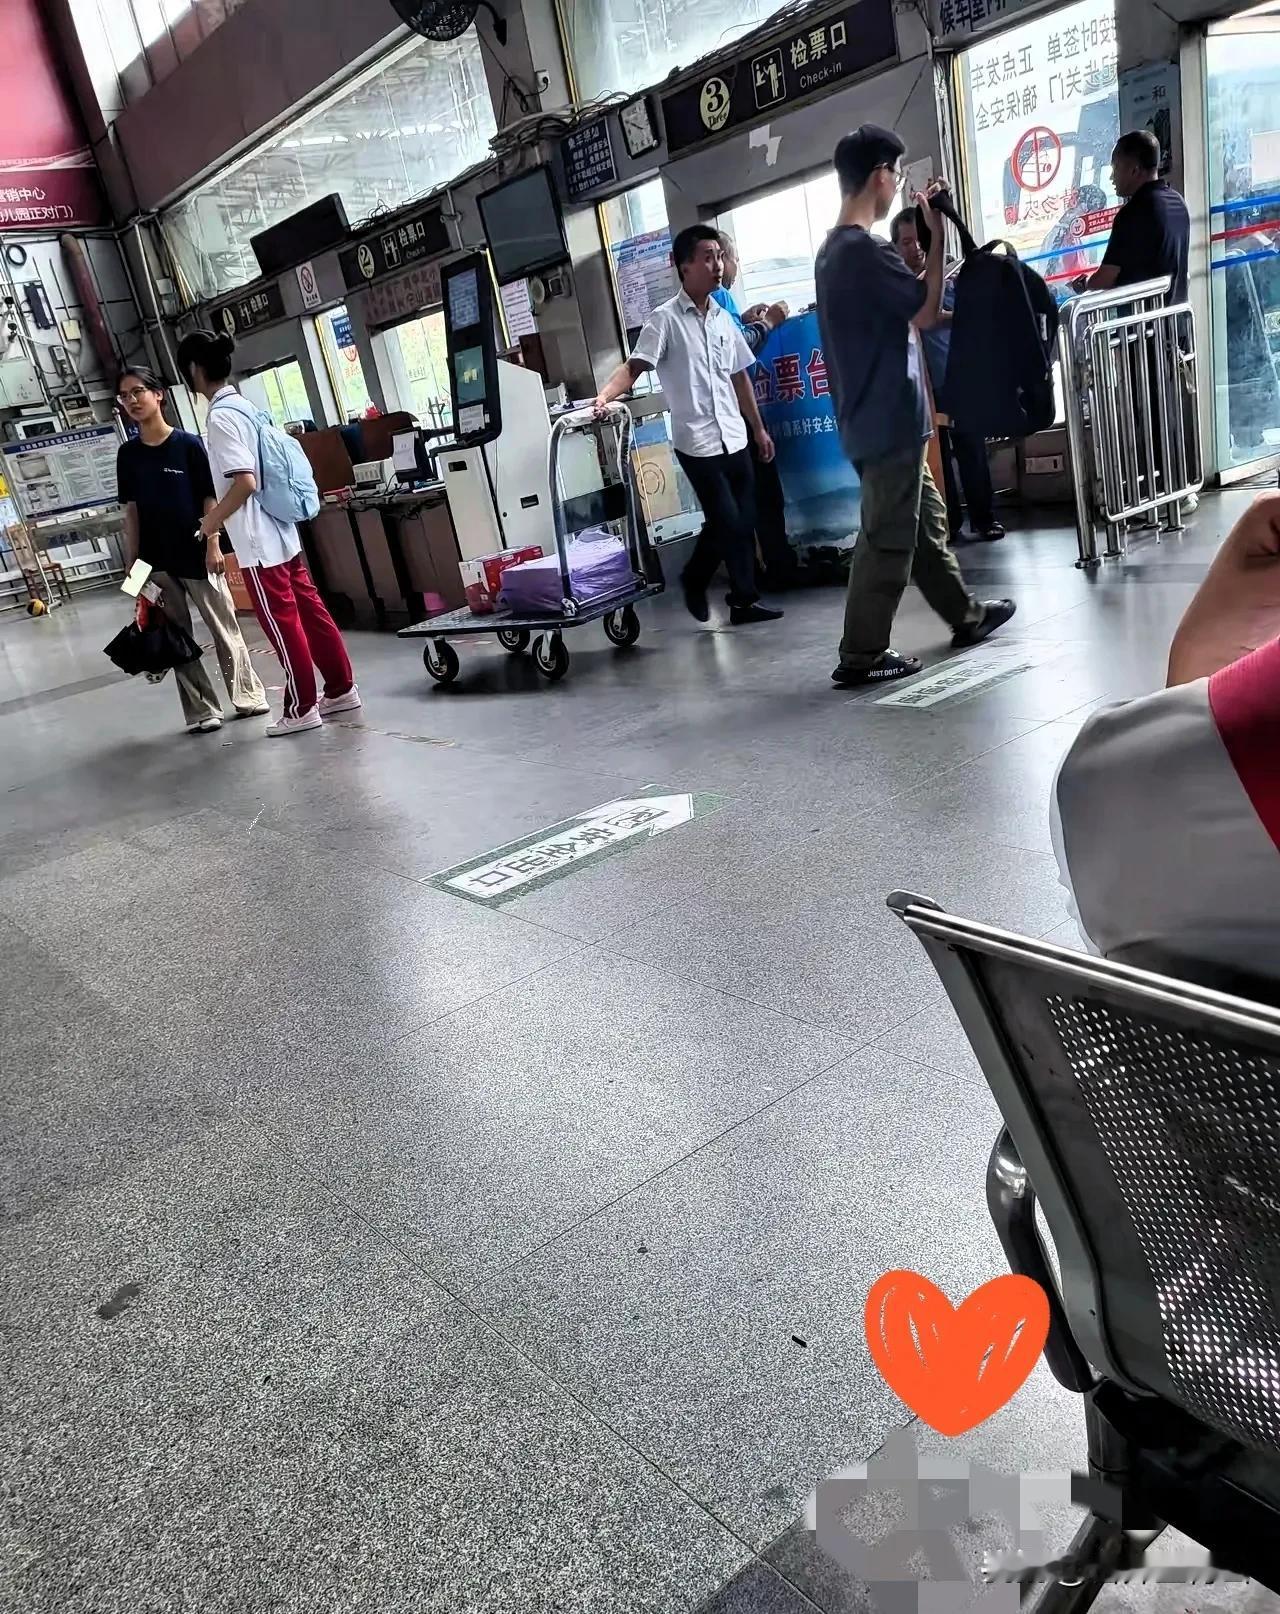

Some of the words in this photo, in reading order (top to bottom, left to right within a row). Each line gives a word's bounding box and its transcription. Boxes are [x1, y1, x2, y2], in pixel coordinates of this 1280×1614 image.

[790, 21, 847, 70] 检票口
[800, 61, 842, 89] Check-in
[706, 80, 723, 113] 3
[707, 111, 728, 129] Three
[399, 221, 426, 248] 检票口
[360, 248, 371, 267] 2
[867, 669, 883, 678] JUST
[884, 668, 893, 676] DO
